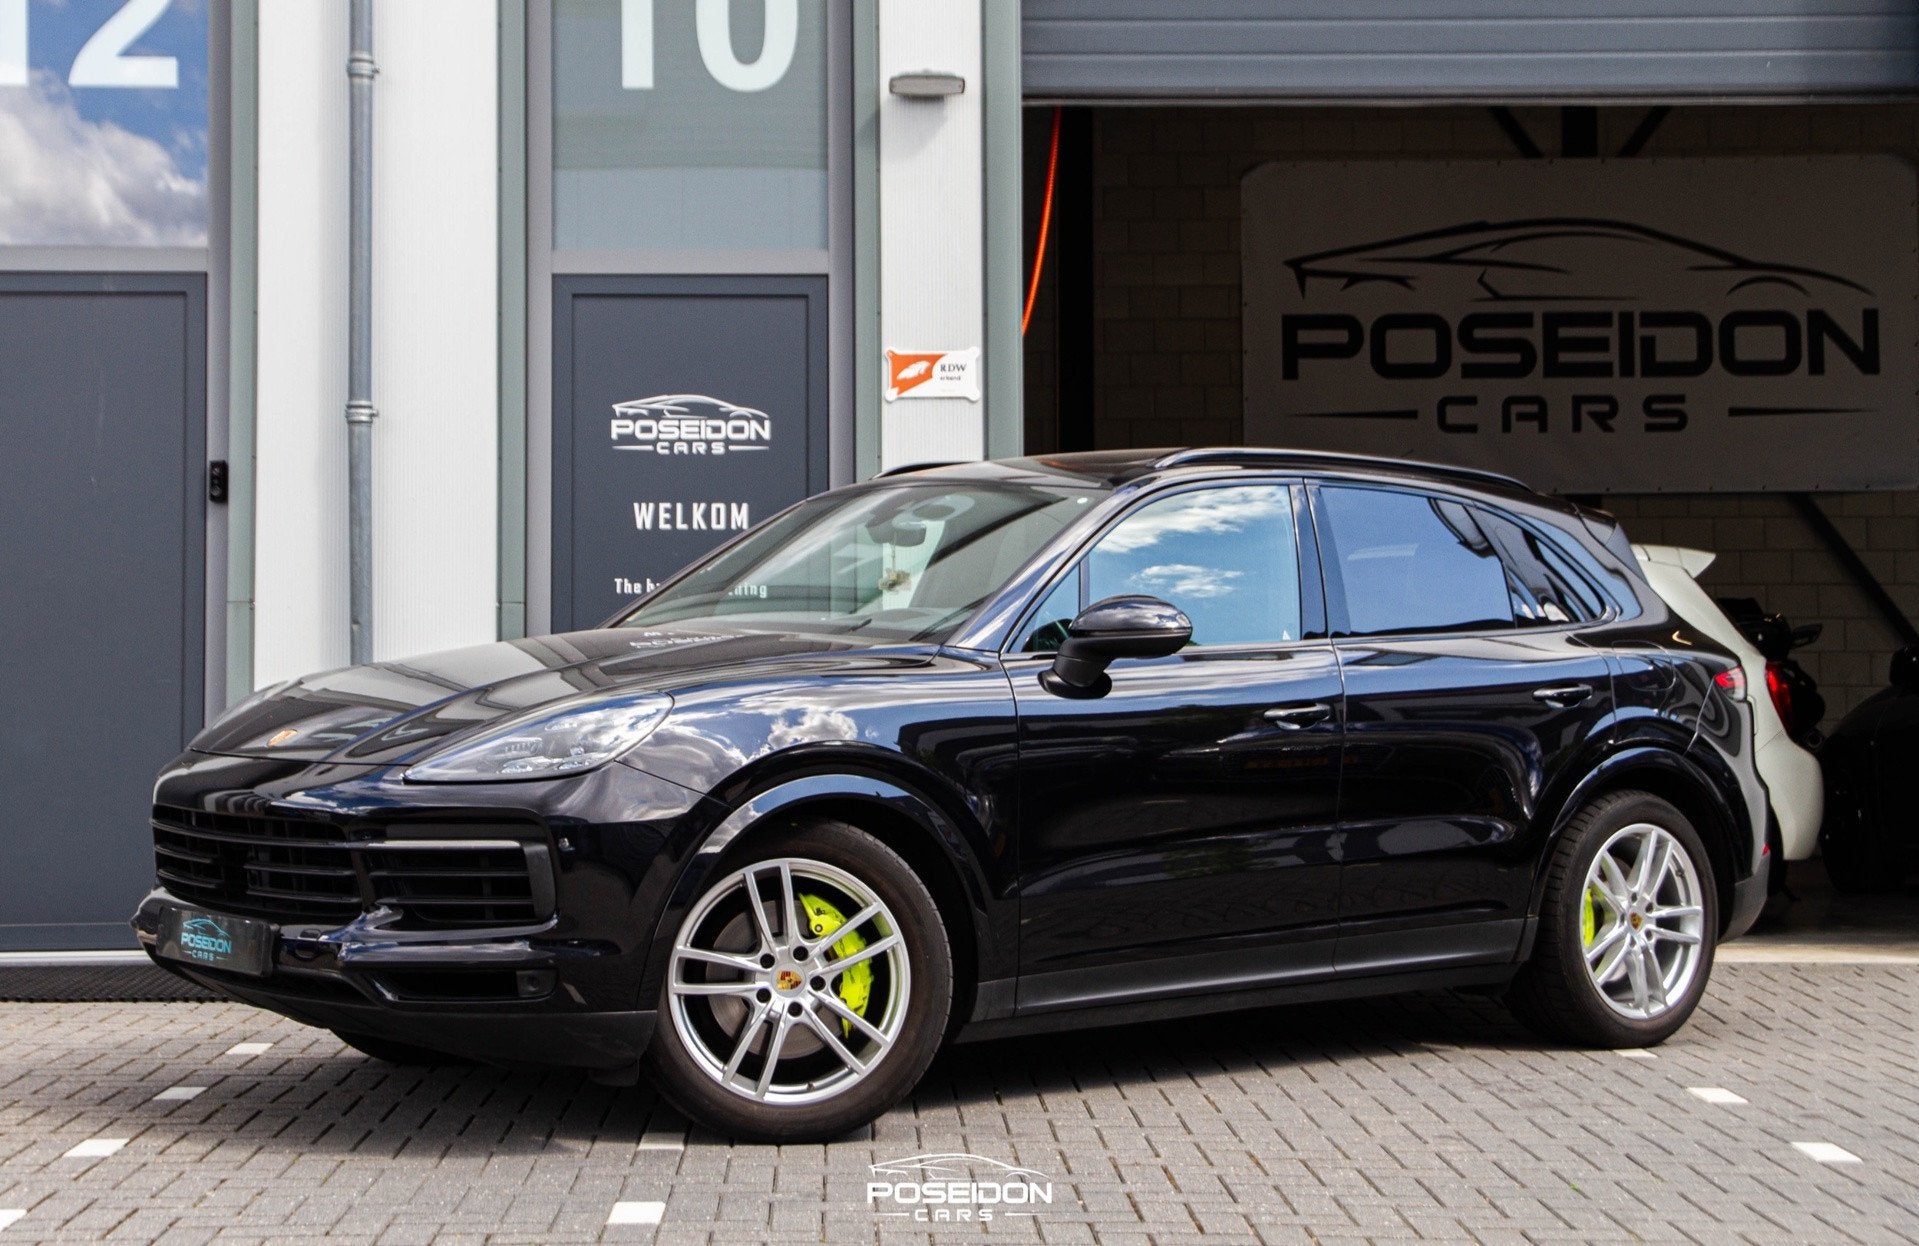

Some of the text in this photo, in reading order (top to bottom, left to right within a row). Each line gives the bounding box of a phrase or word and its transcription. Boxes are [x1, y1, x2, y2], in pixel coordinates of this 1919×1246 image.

[1281, 308, 1881, 380] POSEIDON
[940, 363, 967, 372] RDW
[1436, 394, 1689, 434] CARS
[610, 419, 771, 441] POSEIDON
[656, 441, 726, 455] CARS
[633, 502, 750, 531] WELKOM
[614, 578, 642, 595] The
[181, 932, 233, 955] POSEIDON
[191, 949, 215, 962] CARS
